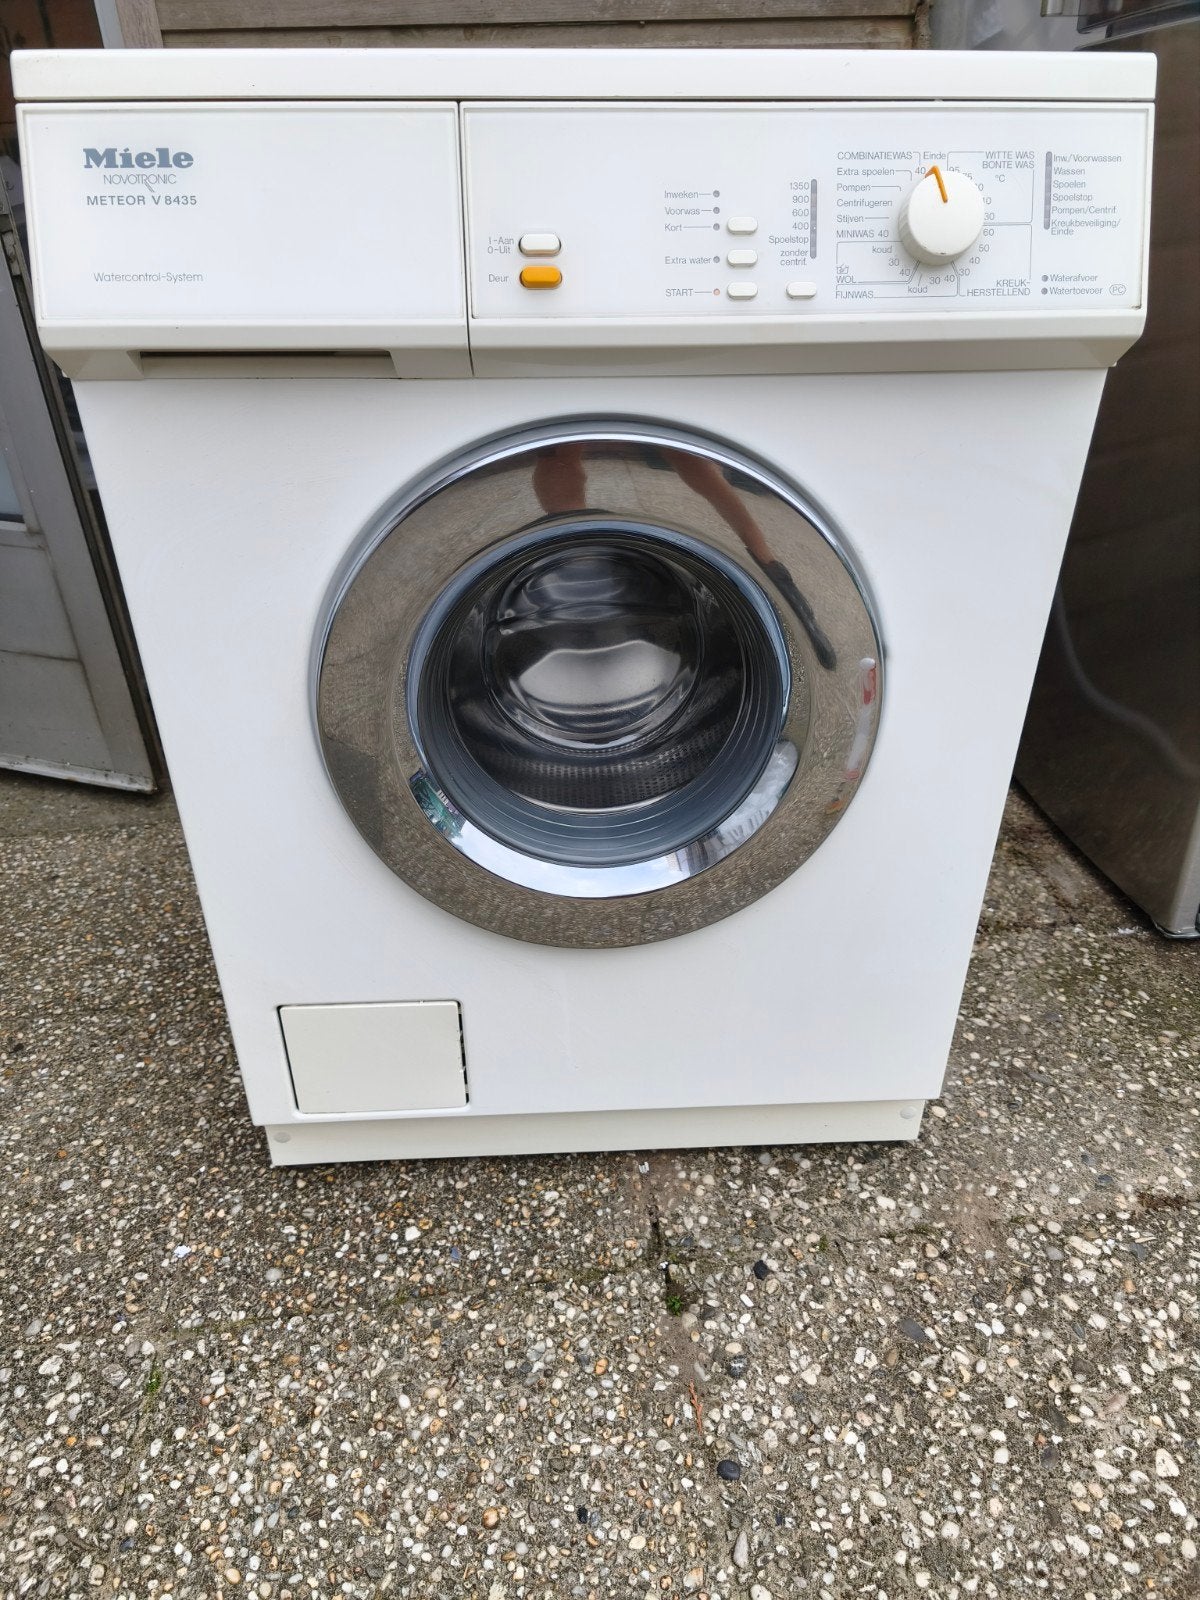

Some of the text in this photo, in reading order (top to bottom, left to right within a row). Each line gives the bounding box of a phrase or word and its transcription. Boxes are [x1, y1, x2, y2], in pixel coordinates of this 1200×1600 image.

[83, 147, 194, 169] Miele
[837, 151, 913, 160] COMBINATIEWAS
[923, 151, 947, 160] Einde
[985, 151, 1035, 160] WITTE WAS
[982, 160, 1035, 169] BONTE WAS
[836, 167, 895, 178] Extra spoelen
[915, 166, 926, 175] 40
[1053, 167, 1086, 175] Wassen
[103, 173, 177, 193] NOVOTRONIC
[789, 181, 810, 190] 1350
[836, 183, 871, 192] Pompen
[1052, 180, 1086, 189] Spoelen
[664, 190, 699, 199] Inweken
[1052, 193, 1093, 202] Spoelstop
[87, 195, 198, 206] METEOR V 8435
[792, 195, 810, 204] 900
[836, 198, 893, 208] Centrifugeren
[665, 206, 701, 215] Voorwas
[792, 208, 810, 217] 600
[836, 214, 865, 224] Stijven
[984, 212, 995, 221] 30
[664, 222, 683, 232] Kort
[792, 221, 810, 230] 400
[836, 229, 890, 239] MINIWAS 40
[982, 228, 995, 237] 60
[1050, 227, 1075, 236] Einde
[768, 235, 810, 246] Spoelstop
[780, 248, 809, 257] zonder
[871, 245, 893, 254] koud
[978, 243, 990, 253] 50
[665, 256, 712, 265] Extra water
[888, 258, 900, 267] 30
[968, 256, 981, 265] 40
[899, 268, 912, 277] 40
[958, 268, 971, 277] 30
[93, 271, 204, 285] Watercontrol-System
[488, 273, 509, 283] Deur
[836, 275, 857, 284] WOL
[929, 276, 941, 285] 30
[943, 274, 956, 283] 40
[1050, 274, 1098, 282] Waterafvoer
[996, 278, 1031, 288] KREUK-
[665, 288, 694, 297] START
[907, 285, 928, 294] koud
[966, 287, 1031, 297] HERSTELLEND
[1049, 287, 1103, 295] Watertoevoer
[835, 290, 875, 299] FIJNWAS
